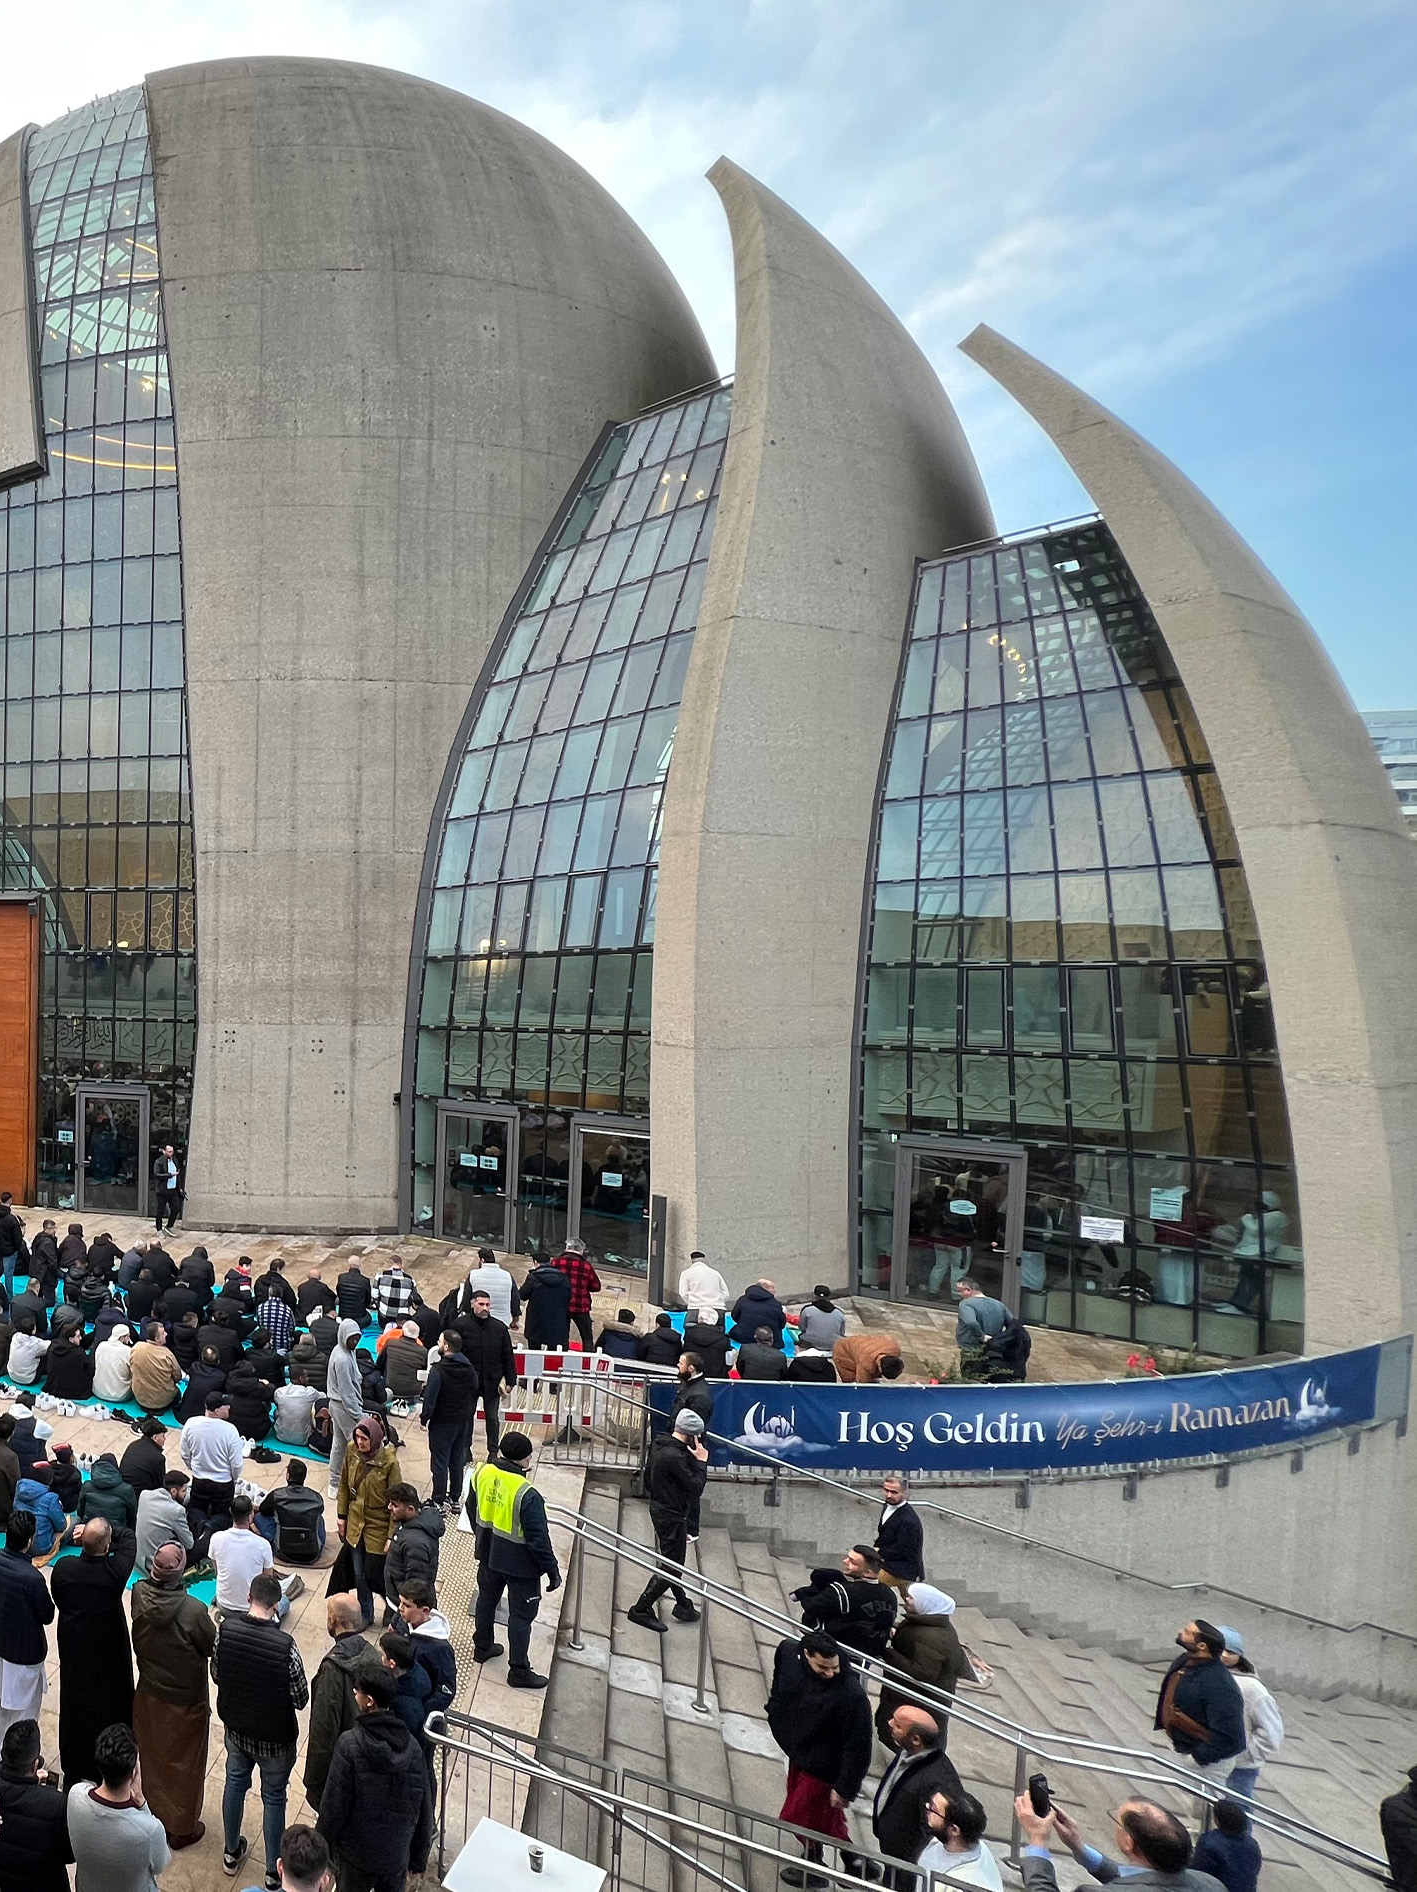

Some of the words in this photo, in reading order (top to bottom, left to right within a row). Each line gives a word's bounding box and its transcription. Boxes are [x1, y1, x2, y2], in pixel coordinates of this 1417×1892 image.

[837, 1411, 915, 1452] Hoş
[923, 1411, 1046, 1444] Geldin
[1056, 1412, 1088, 1450] Ya
[1093, 1409, 1164, 1446] Şehr-i
[1169, 1396, 1291, 1433] Ramazan
